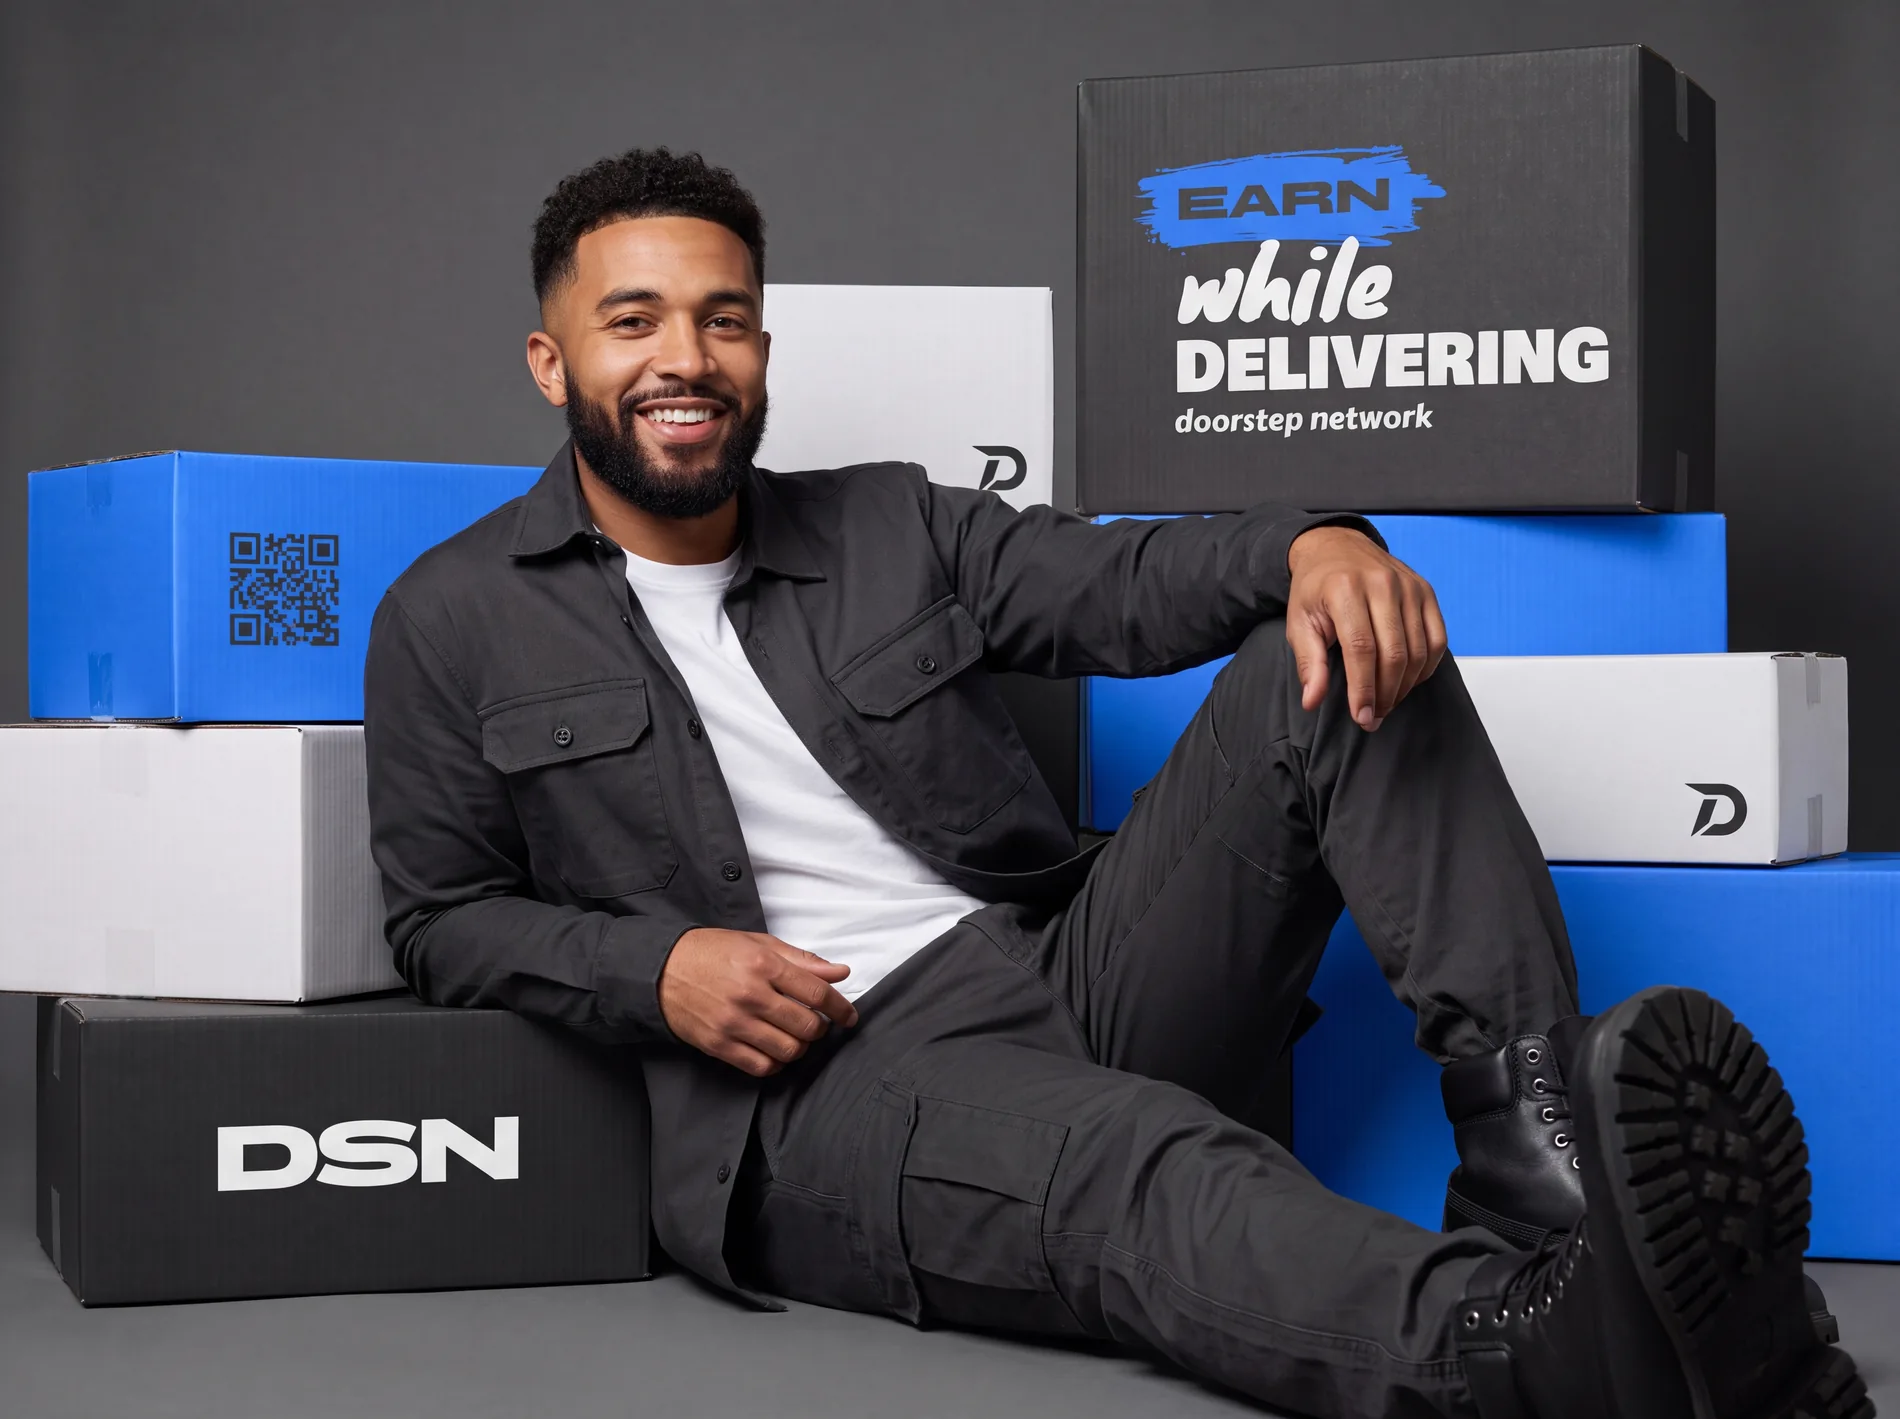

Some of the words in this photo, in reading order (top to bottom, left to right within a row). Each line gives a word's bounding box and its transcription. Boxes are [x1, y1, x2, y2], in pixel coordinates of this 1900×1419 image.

[1178, 178, 1390, 221] EARN
[1177, 236, 1393, 326] while
[1176, 326, 1610, 393] DELIVERING
[1175, 407, 1303, 439] doorstep
[1310, 402, 1434, 431] network
[217, 1115, 520, 1192] DSN
